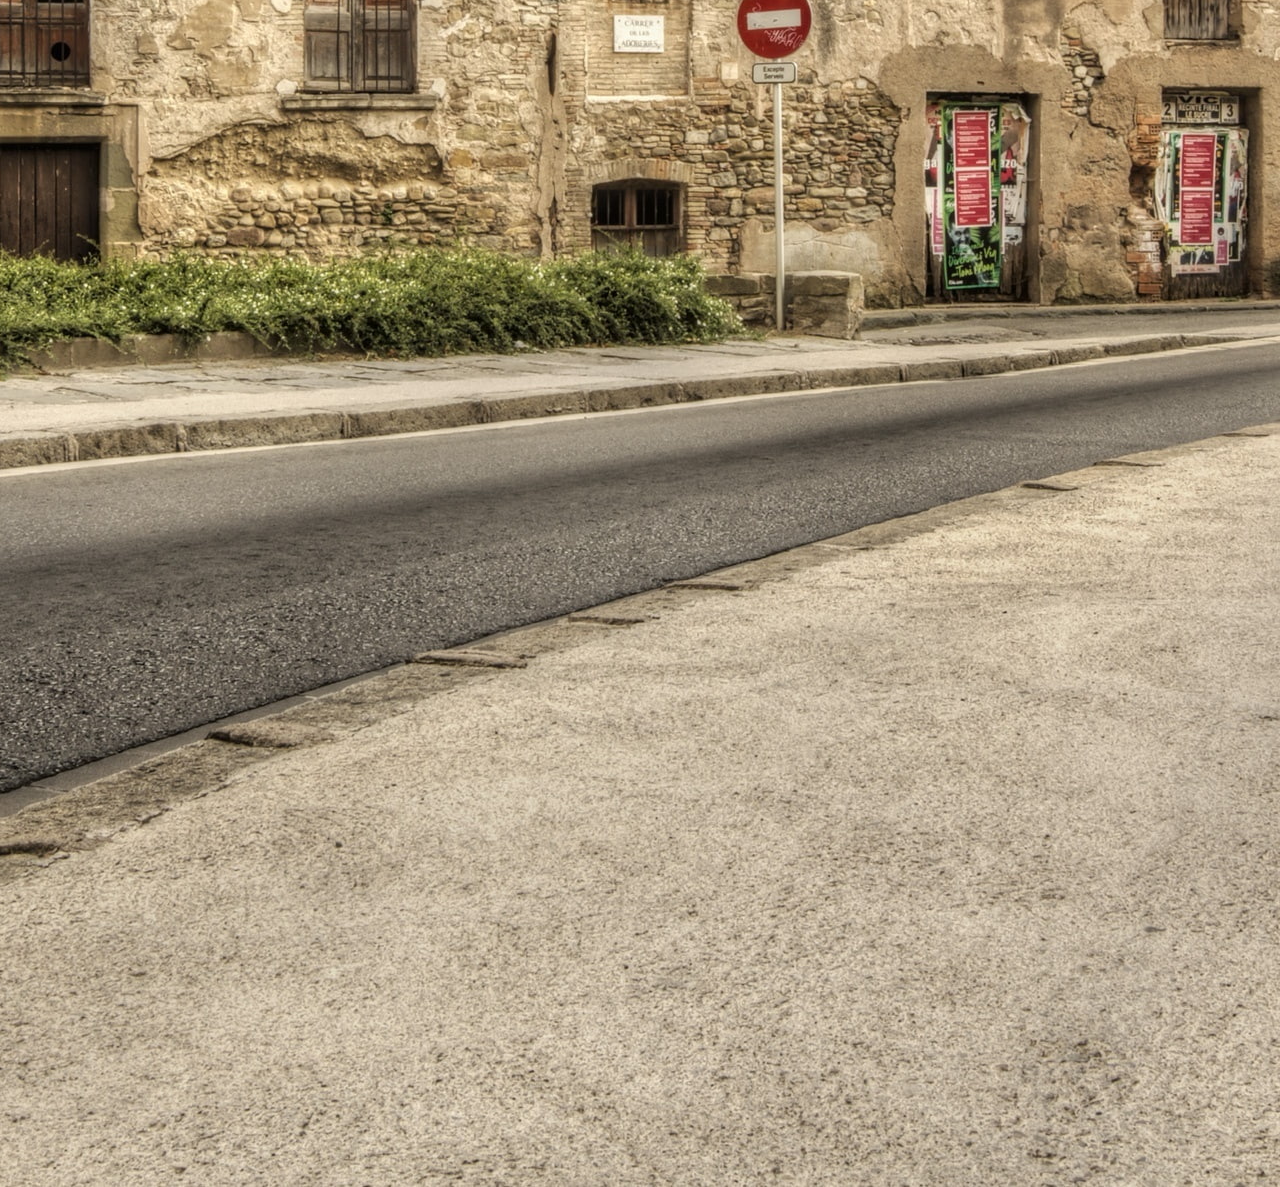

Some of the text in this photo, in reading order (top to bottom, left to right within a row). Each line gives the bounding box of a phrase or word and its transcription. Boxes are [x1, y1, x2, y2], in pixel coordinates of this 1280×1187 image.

[763, 66, 785, 74] Excepte
[1164, 103, 1172, 116] 2
[1226, 104, 1234, 117] 3
